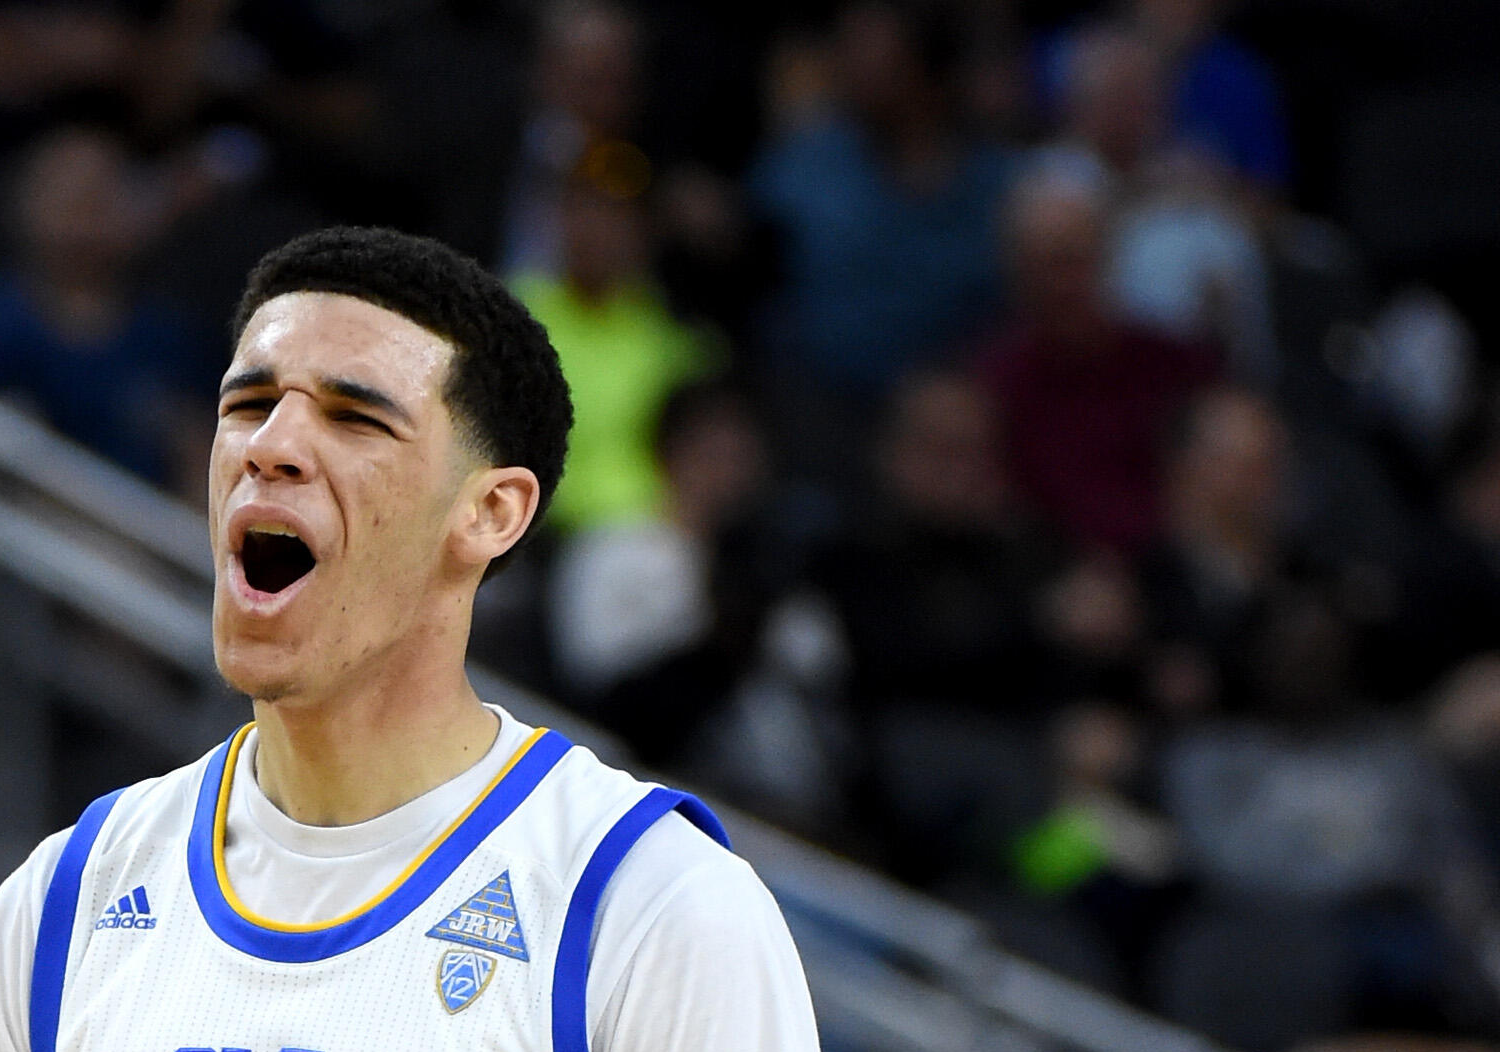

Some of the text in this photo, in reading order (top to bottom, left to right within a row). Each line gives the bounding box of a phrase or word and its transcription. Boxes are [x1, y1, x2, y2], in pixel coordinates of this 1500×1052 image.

[94, 912, 157, 931] adidas
[449, 911, 517, 944] JRW
[440, 952, 493, 992] PAC
[445, 976, 476, 1001] 12
